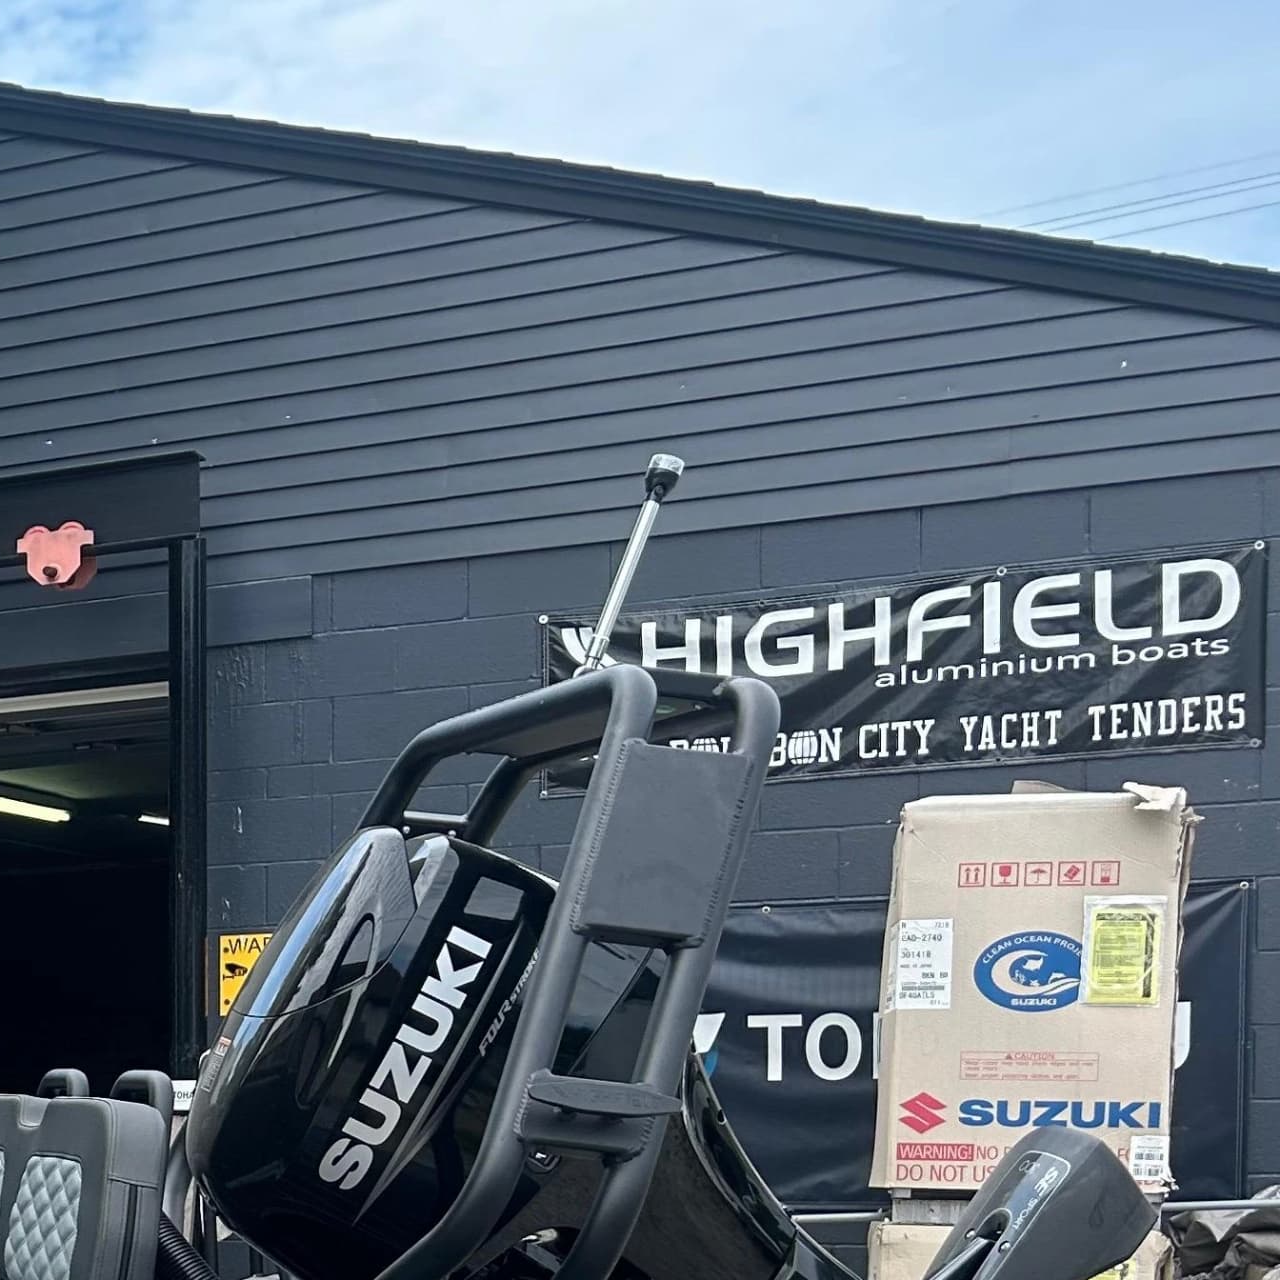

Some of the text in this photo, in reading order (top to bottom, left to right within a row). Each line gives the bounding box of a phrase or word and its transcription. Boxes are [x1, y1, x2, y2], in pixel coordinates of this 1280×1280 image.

[641, 558, 1242, 679] HIGHFIELD
[874, 634, 1231, 689] aluminium boats
[858, 718, 936, 760] CITY
[960, 708, 1064, 753] YACHT
[1088, 692, 1247, 741] TENDERS
[982, 940, 1012, 964] CLEAN
[1014, 935, 1052, 945] OCEAN
[1010, 998, 1057, 1006] SUZUKI
[478, 999, 512, 1057] FOUR
[318, 925, 494, 1191] SUZUKI
[957, 1098, 1162, 1129] SUZUKI
[899, 1143, 974, 1160] WARNING!
[976, 1145, 998, 1160] NO
[896, 1164, 928, 1182] DO
[931, 1165, 969, 1183] NOT
